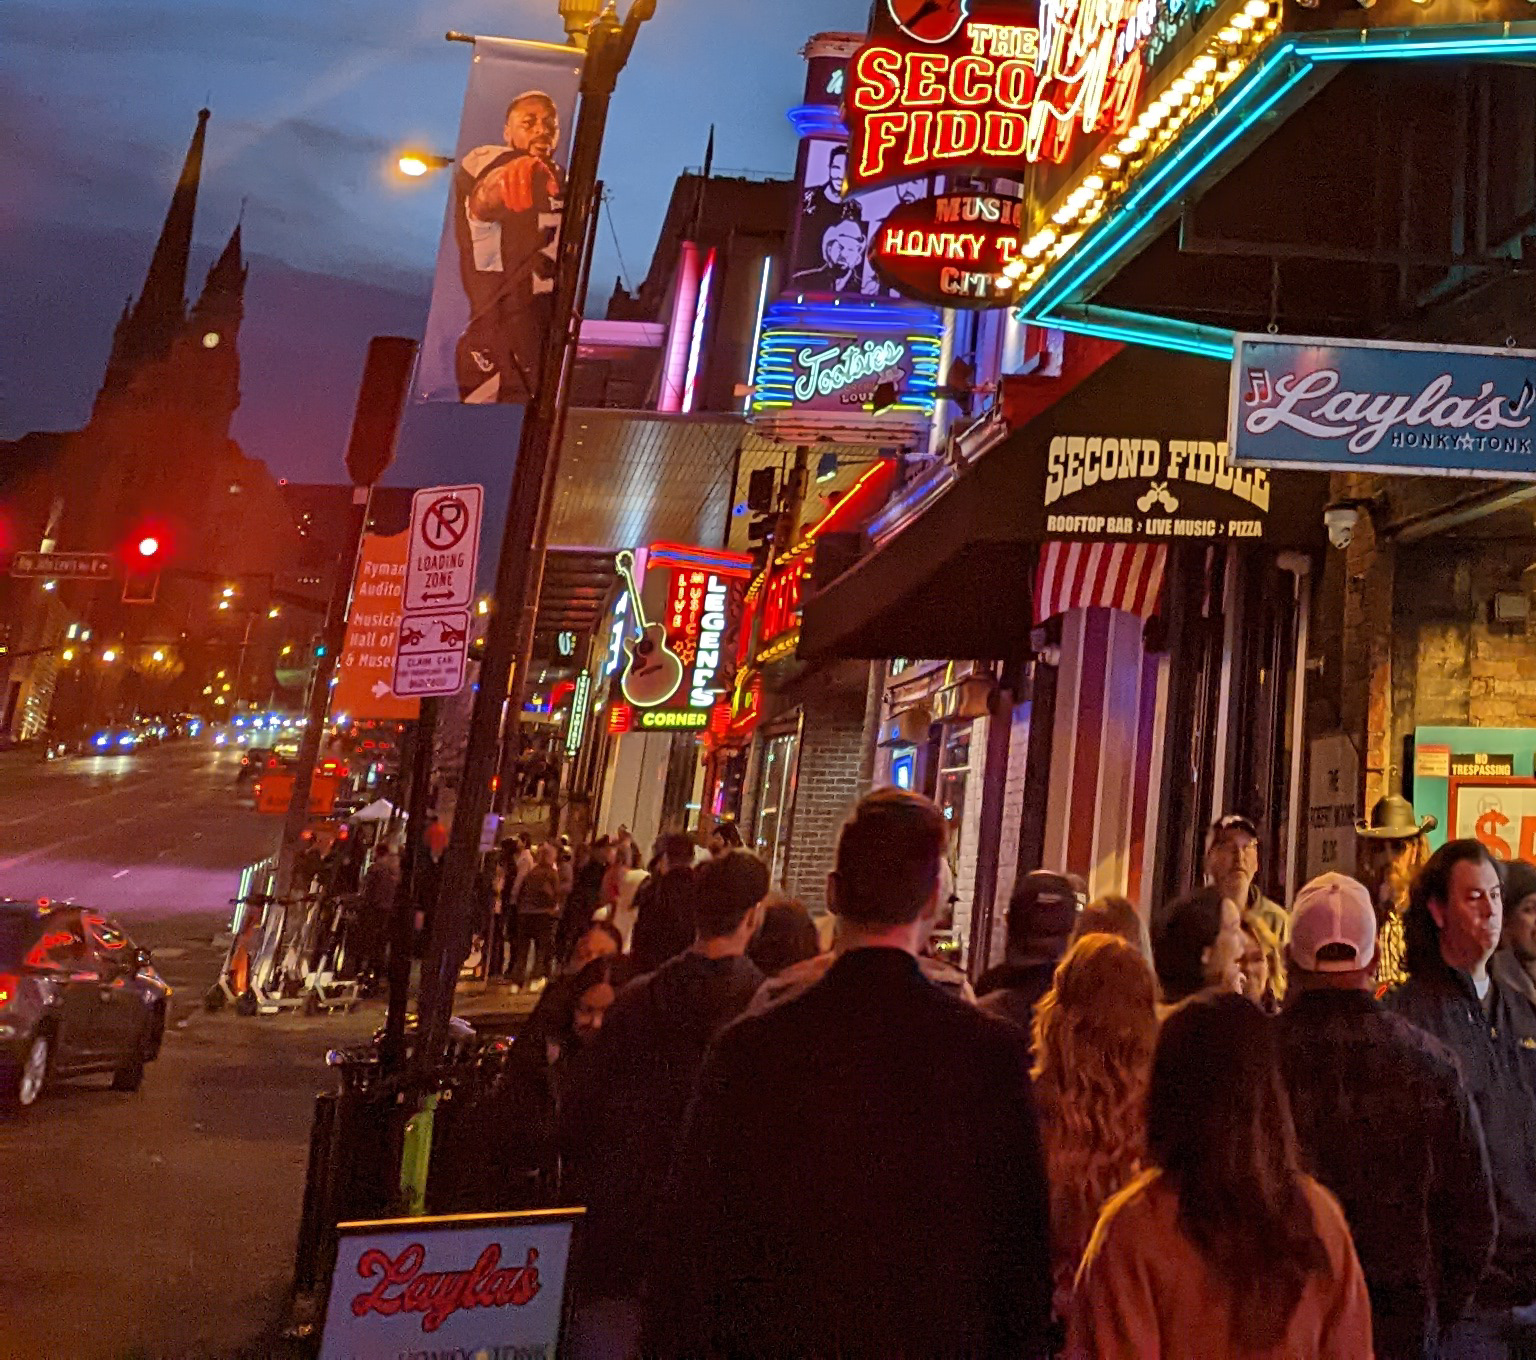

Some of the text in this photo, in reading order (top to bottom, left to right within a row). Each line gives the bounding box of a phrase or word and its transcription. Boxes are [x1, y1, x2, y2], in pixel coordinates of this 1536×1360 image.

[967, 22, 1038, 58] THE
[855, 47, 1036, 111] SECO
[859, 109, 1029, 177] FIDD
[884, 228, 986, 260] HONKY
[795, 340, 904, 401] Tootsies
[1246, 367, 1531, 454] Layla's
[1391, 431, 1532, 454] HONKY TONK
[1044, 435, 1161, 506] SECOND
[1047, 514, 1263, 537] ROOFTOP BAR LIVE MUSIC PIZZA
[417, 552, 465, 572] LOADING
[359, 581, 401, 597] Audito
[424, 571, 454, 589] ZONE
[672, 573, 688, 628] LIVE
[685, 571, 705, 635] MUSIC
[353, 612, 402, 627] Musicia
[349, 631, 396, 647] Hall of
[358, 653, 397, 668] Muse
[643, 712, 707, 727] CORNER
[1451, 763, 1511, 776] TRESPASSING
[1474, 753, 1489, 765] NO
[352, 1243, 544, 1333] Layla's
